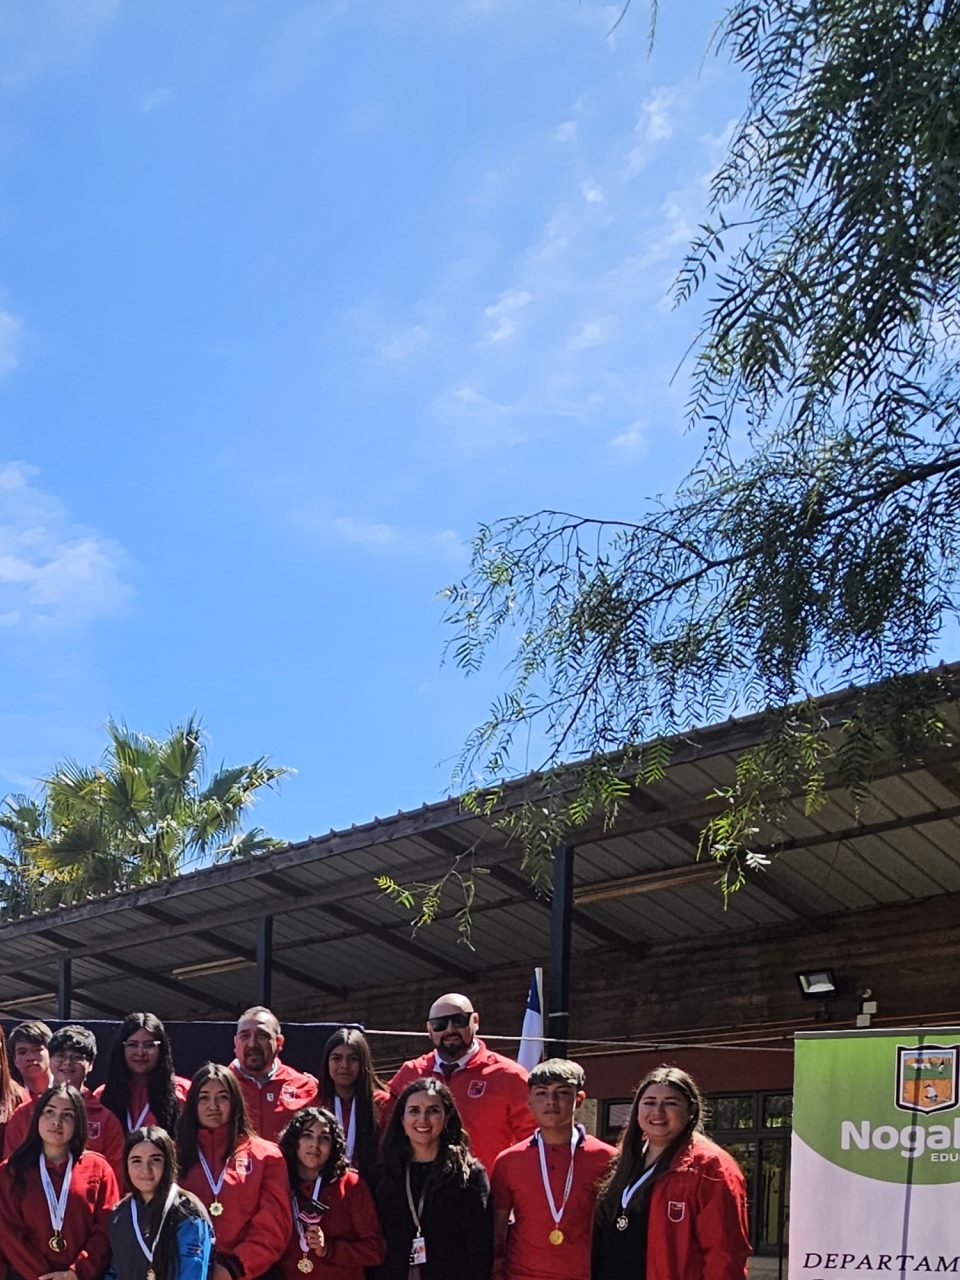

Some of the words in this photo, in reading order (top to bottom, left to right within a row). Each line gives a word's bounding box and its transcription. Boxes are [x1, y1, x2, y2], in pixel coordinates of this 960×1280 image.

[841, 1117, 960, 1158] Nogal
[930, 1153, 960, 1162] EDU
[802, 1253, 960, 1273] DEPARTAM
